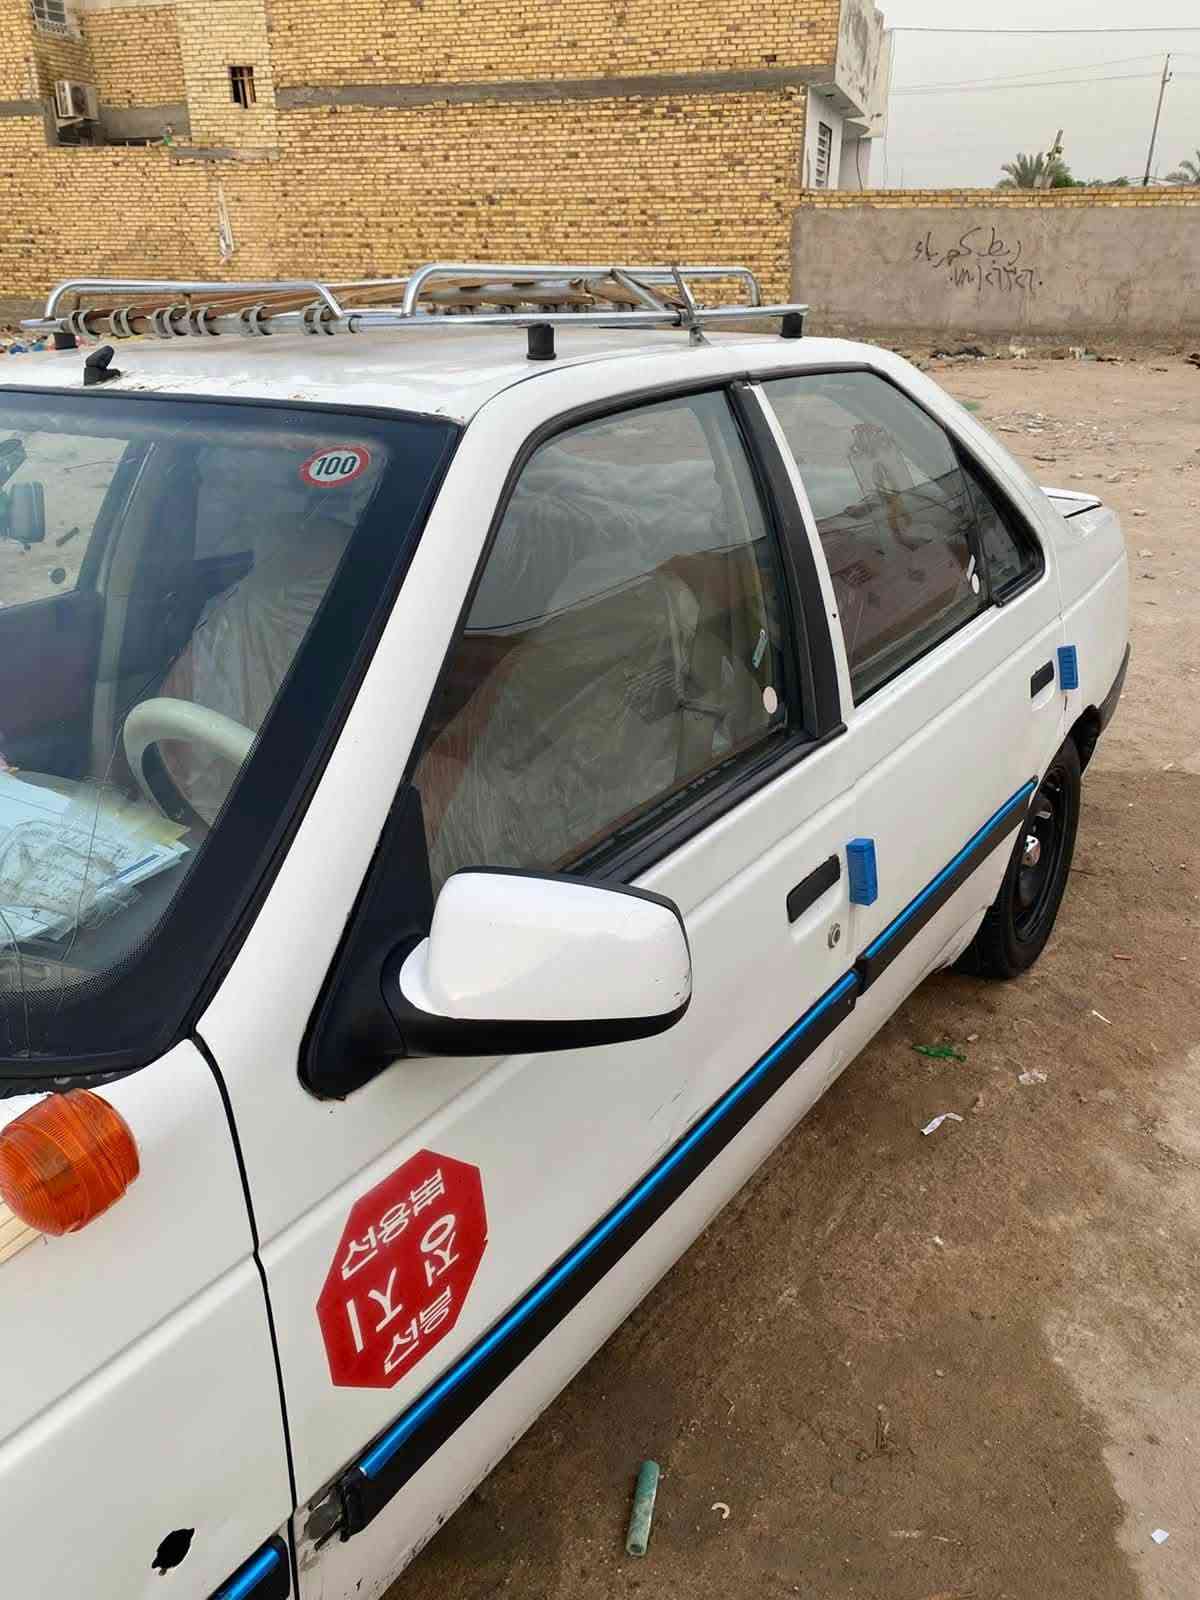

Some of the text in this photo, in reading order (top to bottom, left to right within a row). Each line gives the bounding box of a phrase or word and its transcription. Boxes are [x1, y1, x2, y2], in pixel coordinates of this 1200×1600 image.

[913, 227, 1021, 268] ربط كهرباء
[316, 455, 358, 476] 100
